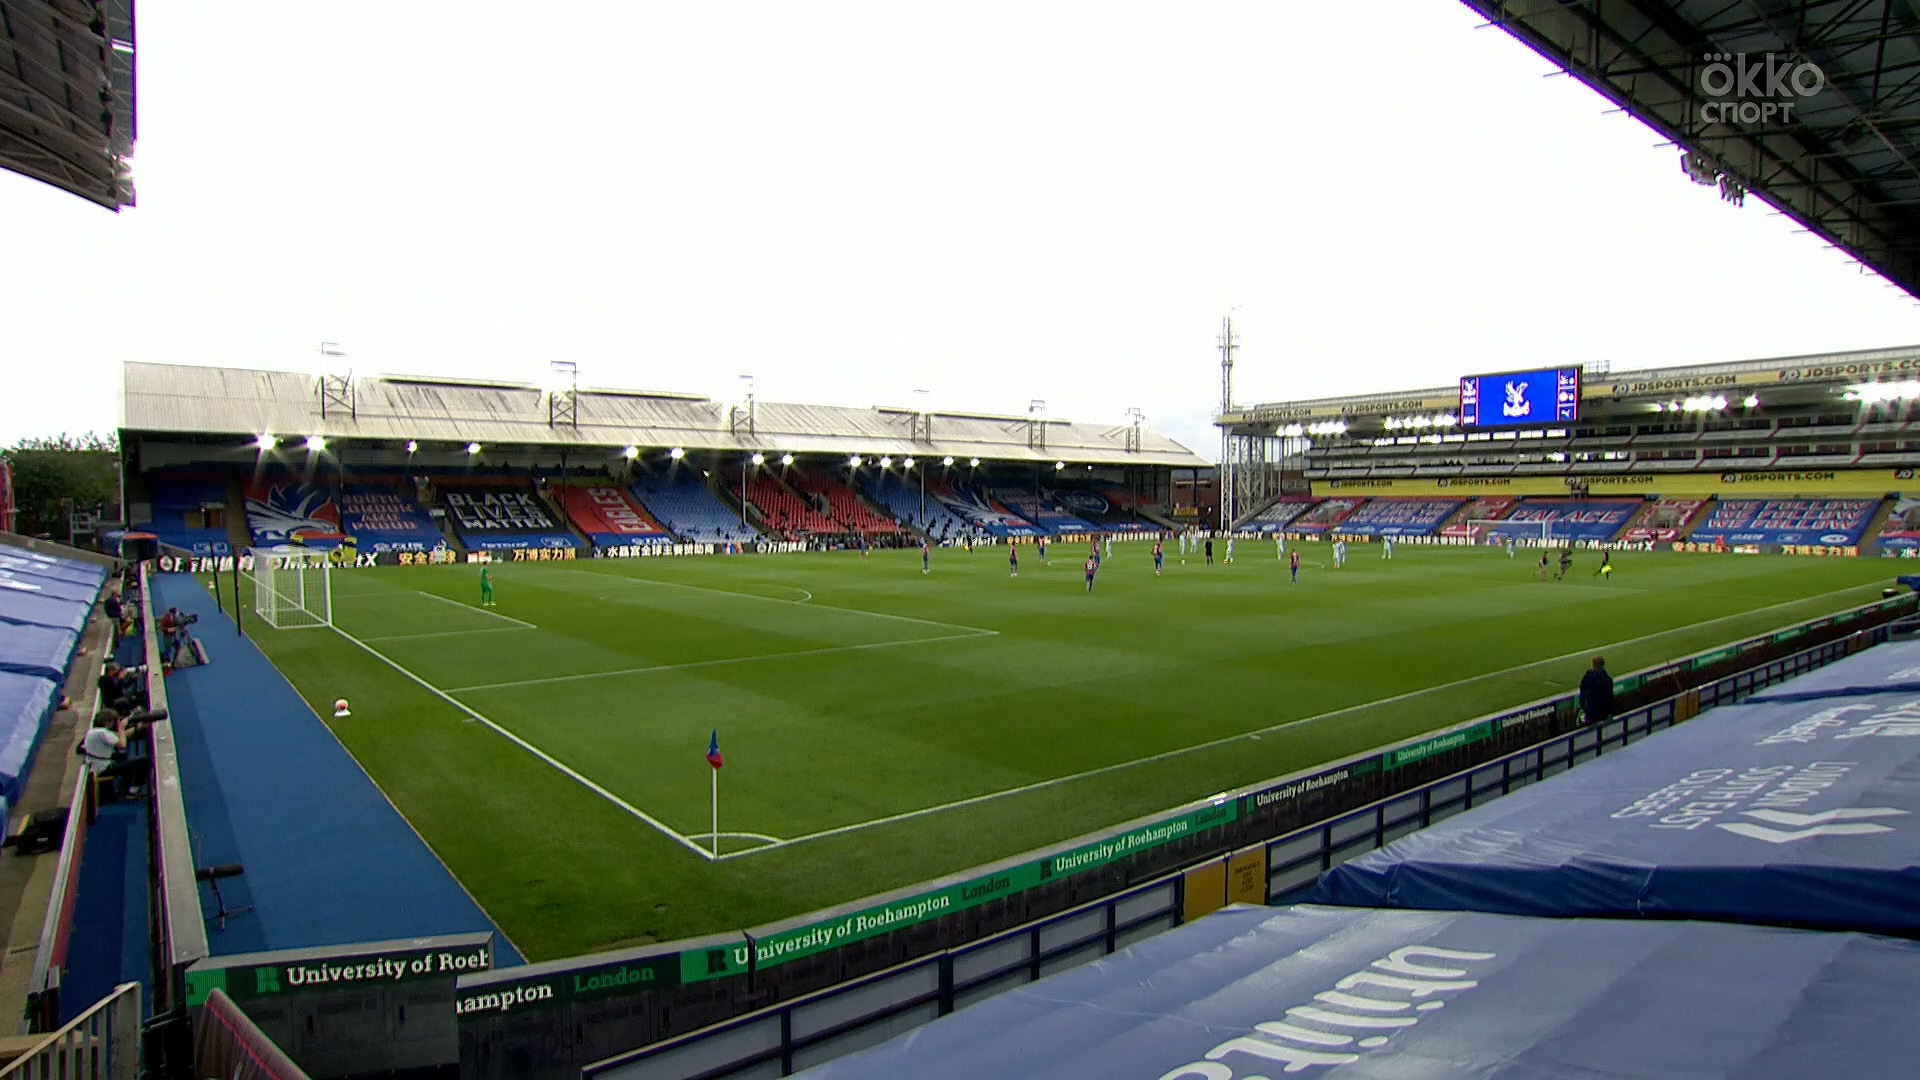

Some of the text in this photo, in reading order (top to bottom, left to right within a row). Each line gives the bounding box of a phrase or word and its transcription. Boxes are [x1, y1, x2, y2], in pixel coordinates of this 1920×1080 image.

[1631, 375, 1736, 393] JDSPORTS.COM
[1355, 400, 1423, 412] JDSPORTS.COM
[1450, 478, 1511, 487] JDSPORTS.COM
[1579, 475, 1653, 484] JDSPORTS.COM
[1739, 472, 1834, 482] JDSPORTS.COM
[447, 493, 536, 506] BLACK
[1722, 501, 1869, 510] WE FOLLOW
[452, 506, 547, 520] LIVES
[1508, 510, 1627, 523] PALACE
[1715, 510, 1864, 519] WE FOLLOW
[461, 518, 554, 529] MATTER
[1708, 519, 1860, 529] WE FOLLOW
[1257, 783, 1296, 807] University
[1297, 780, 1305, 793] of
[1306, 769, 1349, 792] Roehampton
[1055, 843, 1114, 873] University
[1115, 836, 1126, 853] of
[1127, 820, 1188, 850] Roehampton
[733, 927, 833, 966] University
[836, 918, 854, 938] of
[856, 894, 950, 933] Roehampton
[961, 877, 1010, 901] London
[287, 957, 407, 987] University
[411, 951, 434, 974] of
[574, 965, 655, 993] London
